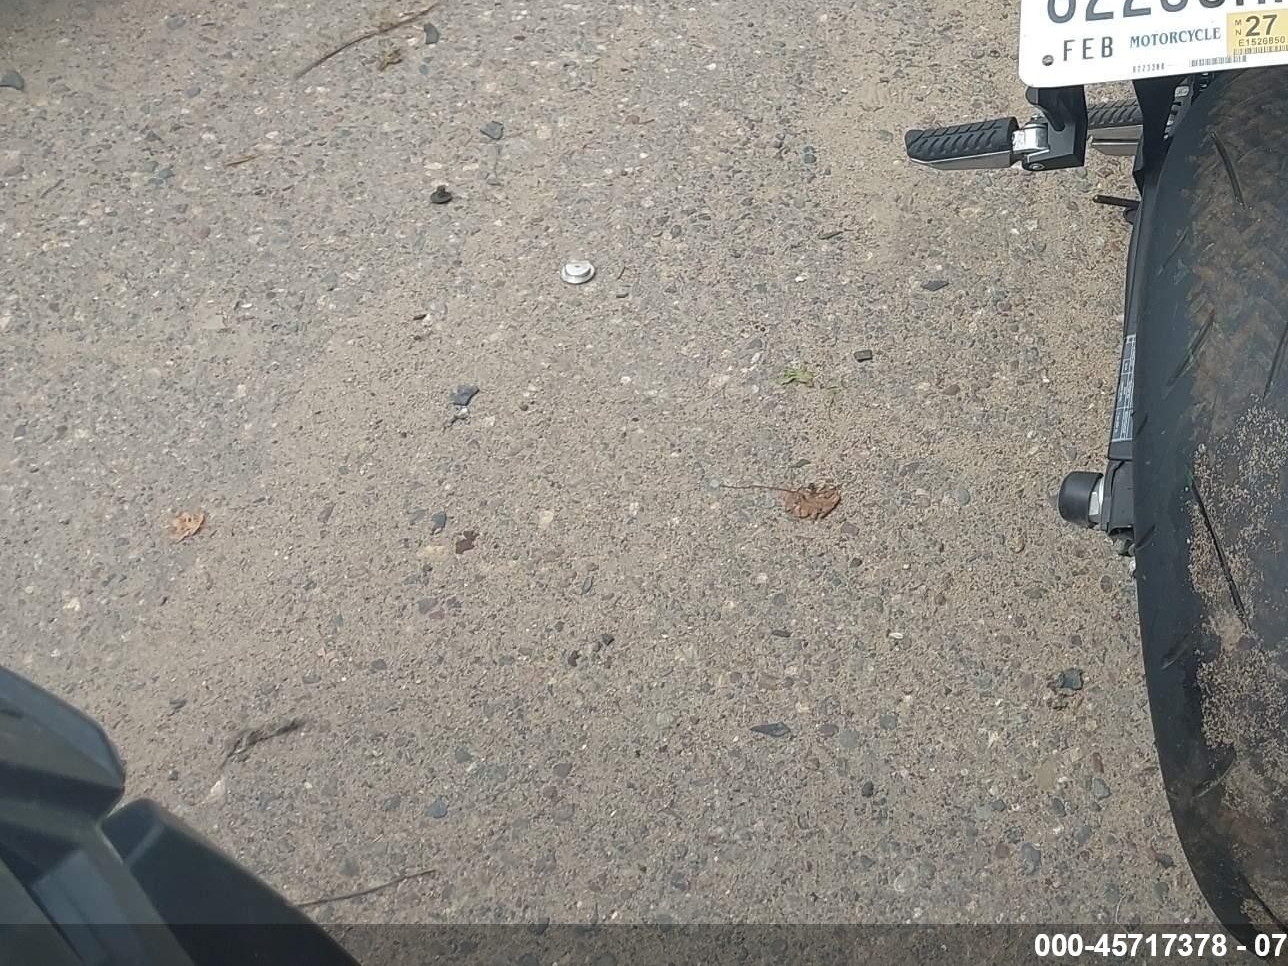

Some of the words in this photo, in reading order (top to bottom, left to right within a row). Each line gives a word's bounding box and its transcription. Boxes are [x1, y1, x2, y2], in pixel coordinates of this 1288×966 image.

[1245, 14, 1277, 37] 27
[1063, 36, 1113, 61] FEB
[1130, 27, 1221, 49] MOTORCYCLE
